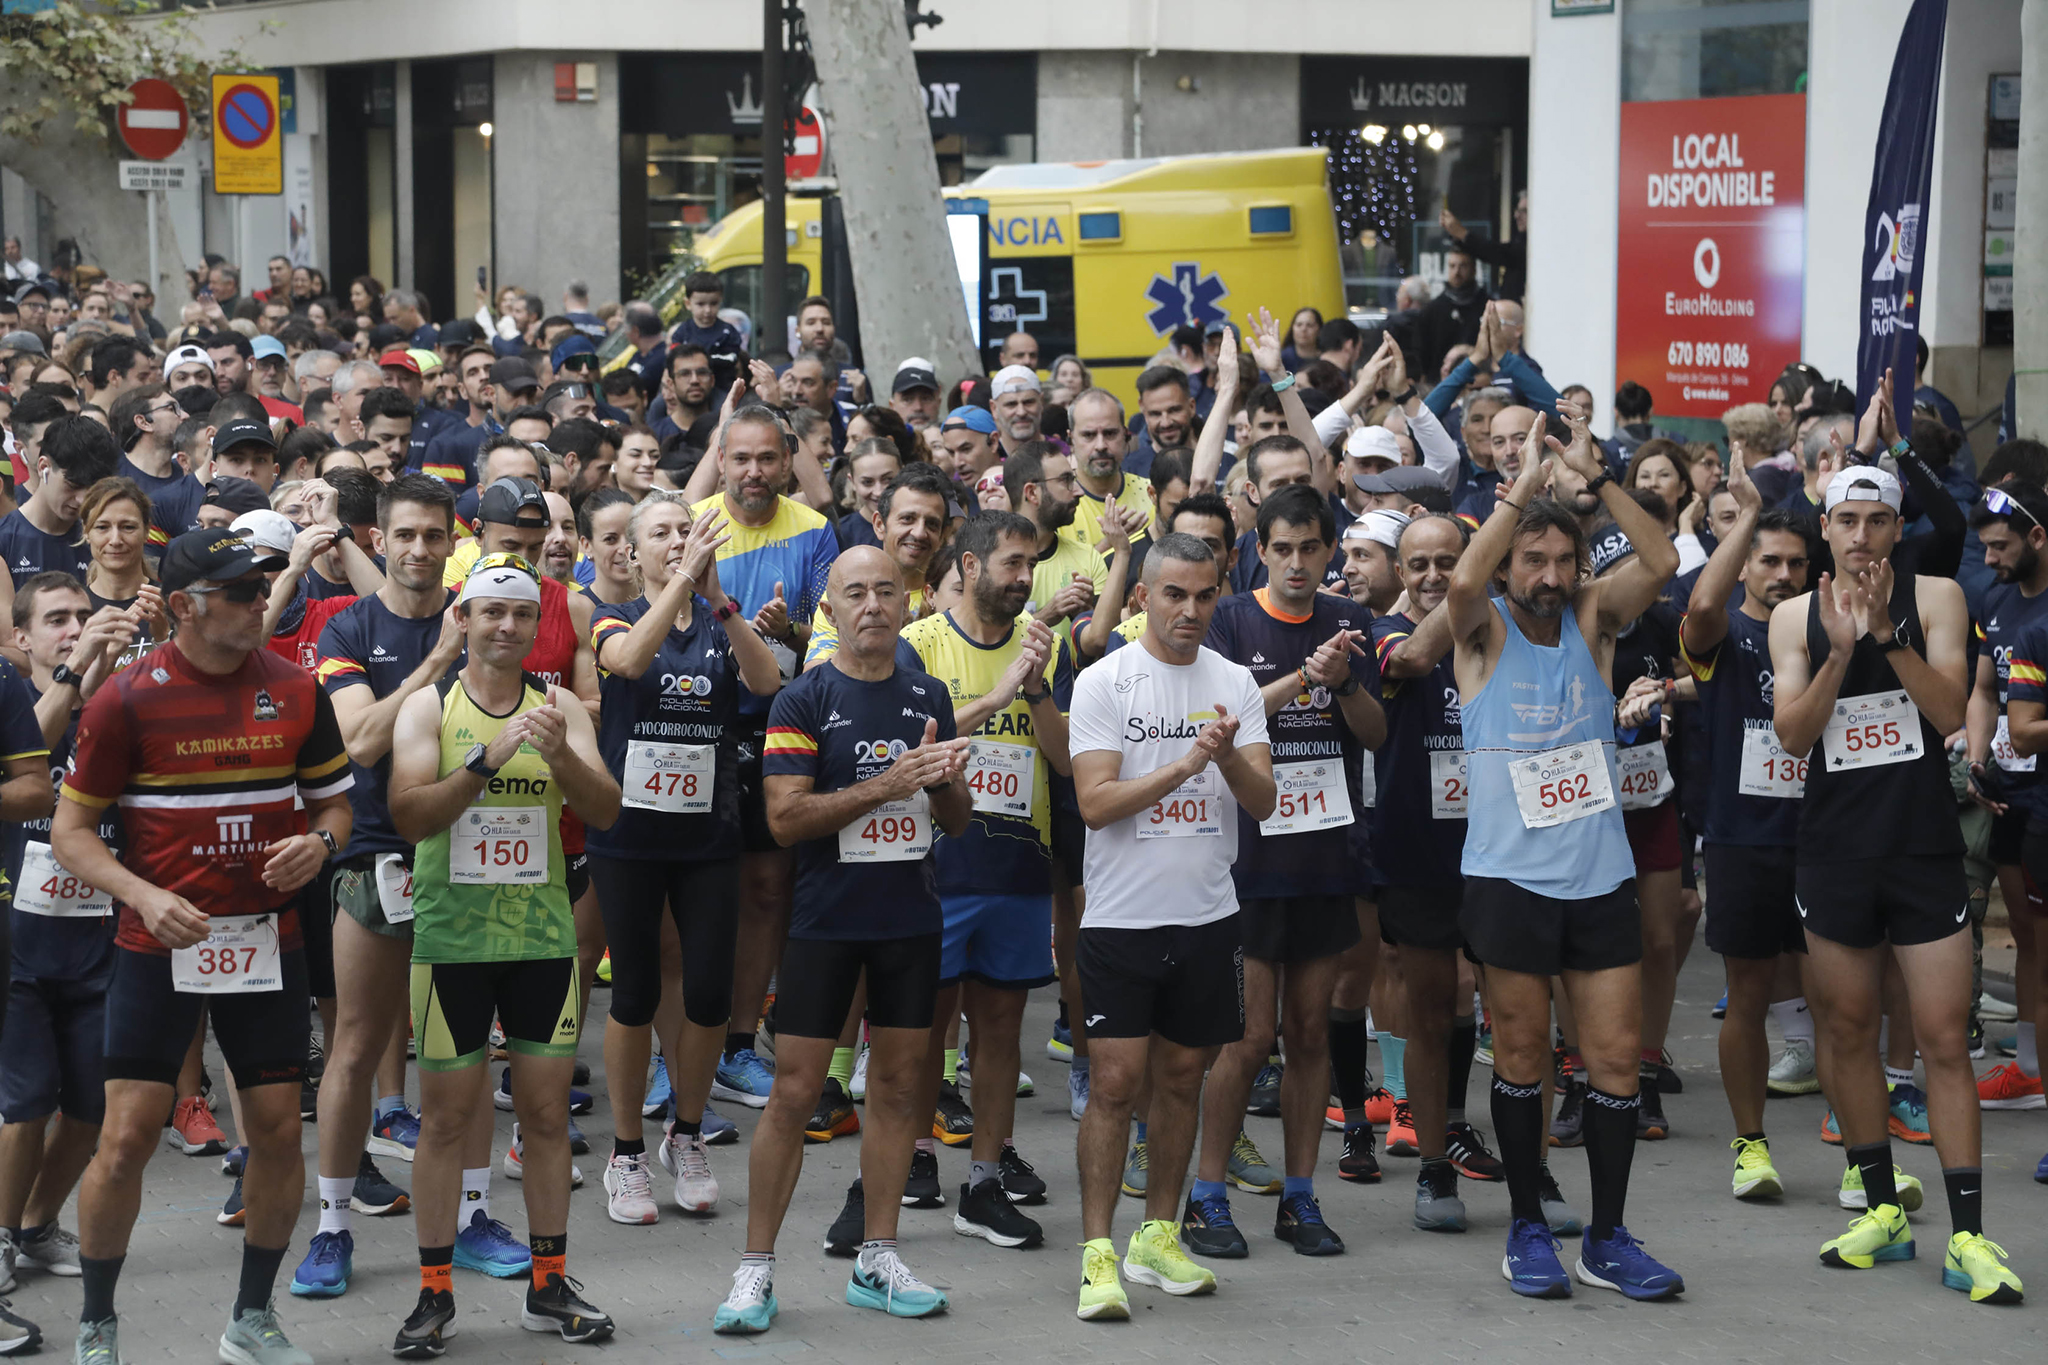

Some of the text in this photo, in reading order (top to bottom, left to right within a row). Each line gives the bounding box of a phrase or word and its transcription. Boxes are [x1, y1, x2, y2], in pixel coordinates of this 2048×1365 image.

[1378, 83, 1467, 107] MACSON
[1673, 133, 1744, 169] LOCAL
[1648, 171, 1775, 207] DISPONIBLE
[1668, 341, 1749, 368] 670 890 086
[11, 566, 41, 574] Santander
[660, 673, 712, 697] 200
[660, 697, 700, 706] POLICIA
[660, 703, 711, 713] NACIONAL
[820, 718, 853, 732] Santander
[1278, 713, 1321, 721] POLICIA
[1278, 719, 1332, 728] NACIONAL
[176, 735, 284, 756] KAMIKAZES
[1846, 721, 1901, 752] 555
[215, 754, 251, 767] GANG
[488, 777, 547, 796] ema
[644, 772, 698, 797] 478
[968, 769, 1018, 797] 480
[1540, 773, 1592, 808] 562
[1621, 770, 1658, 795] 429
[1150, 800, 1208, 824] 3401
[1279, 790, 1327, 818] 511
[861, 816, 916, 844] 499
[473, 839, 529, 866] 150
[40, 875, 95, 899] 485
[197, 948, 257, 975] 387
